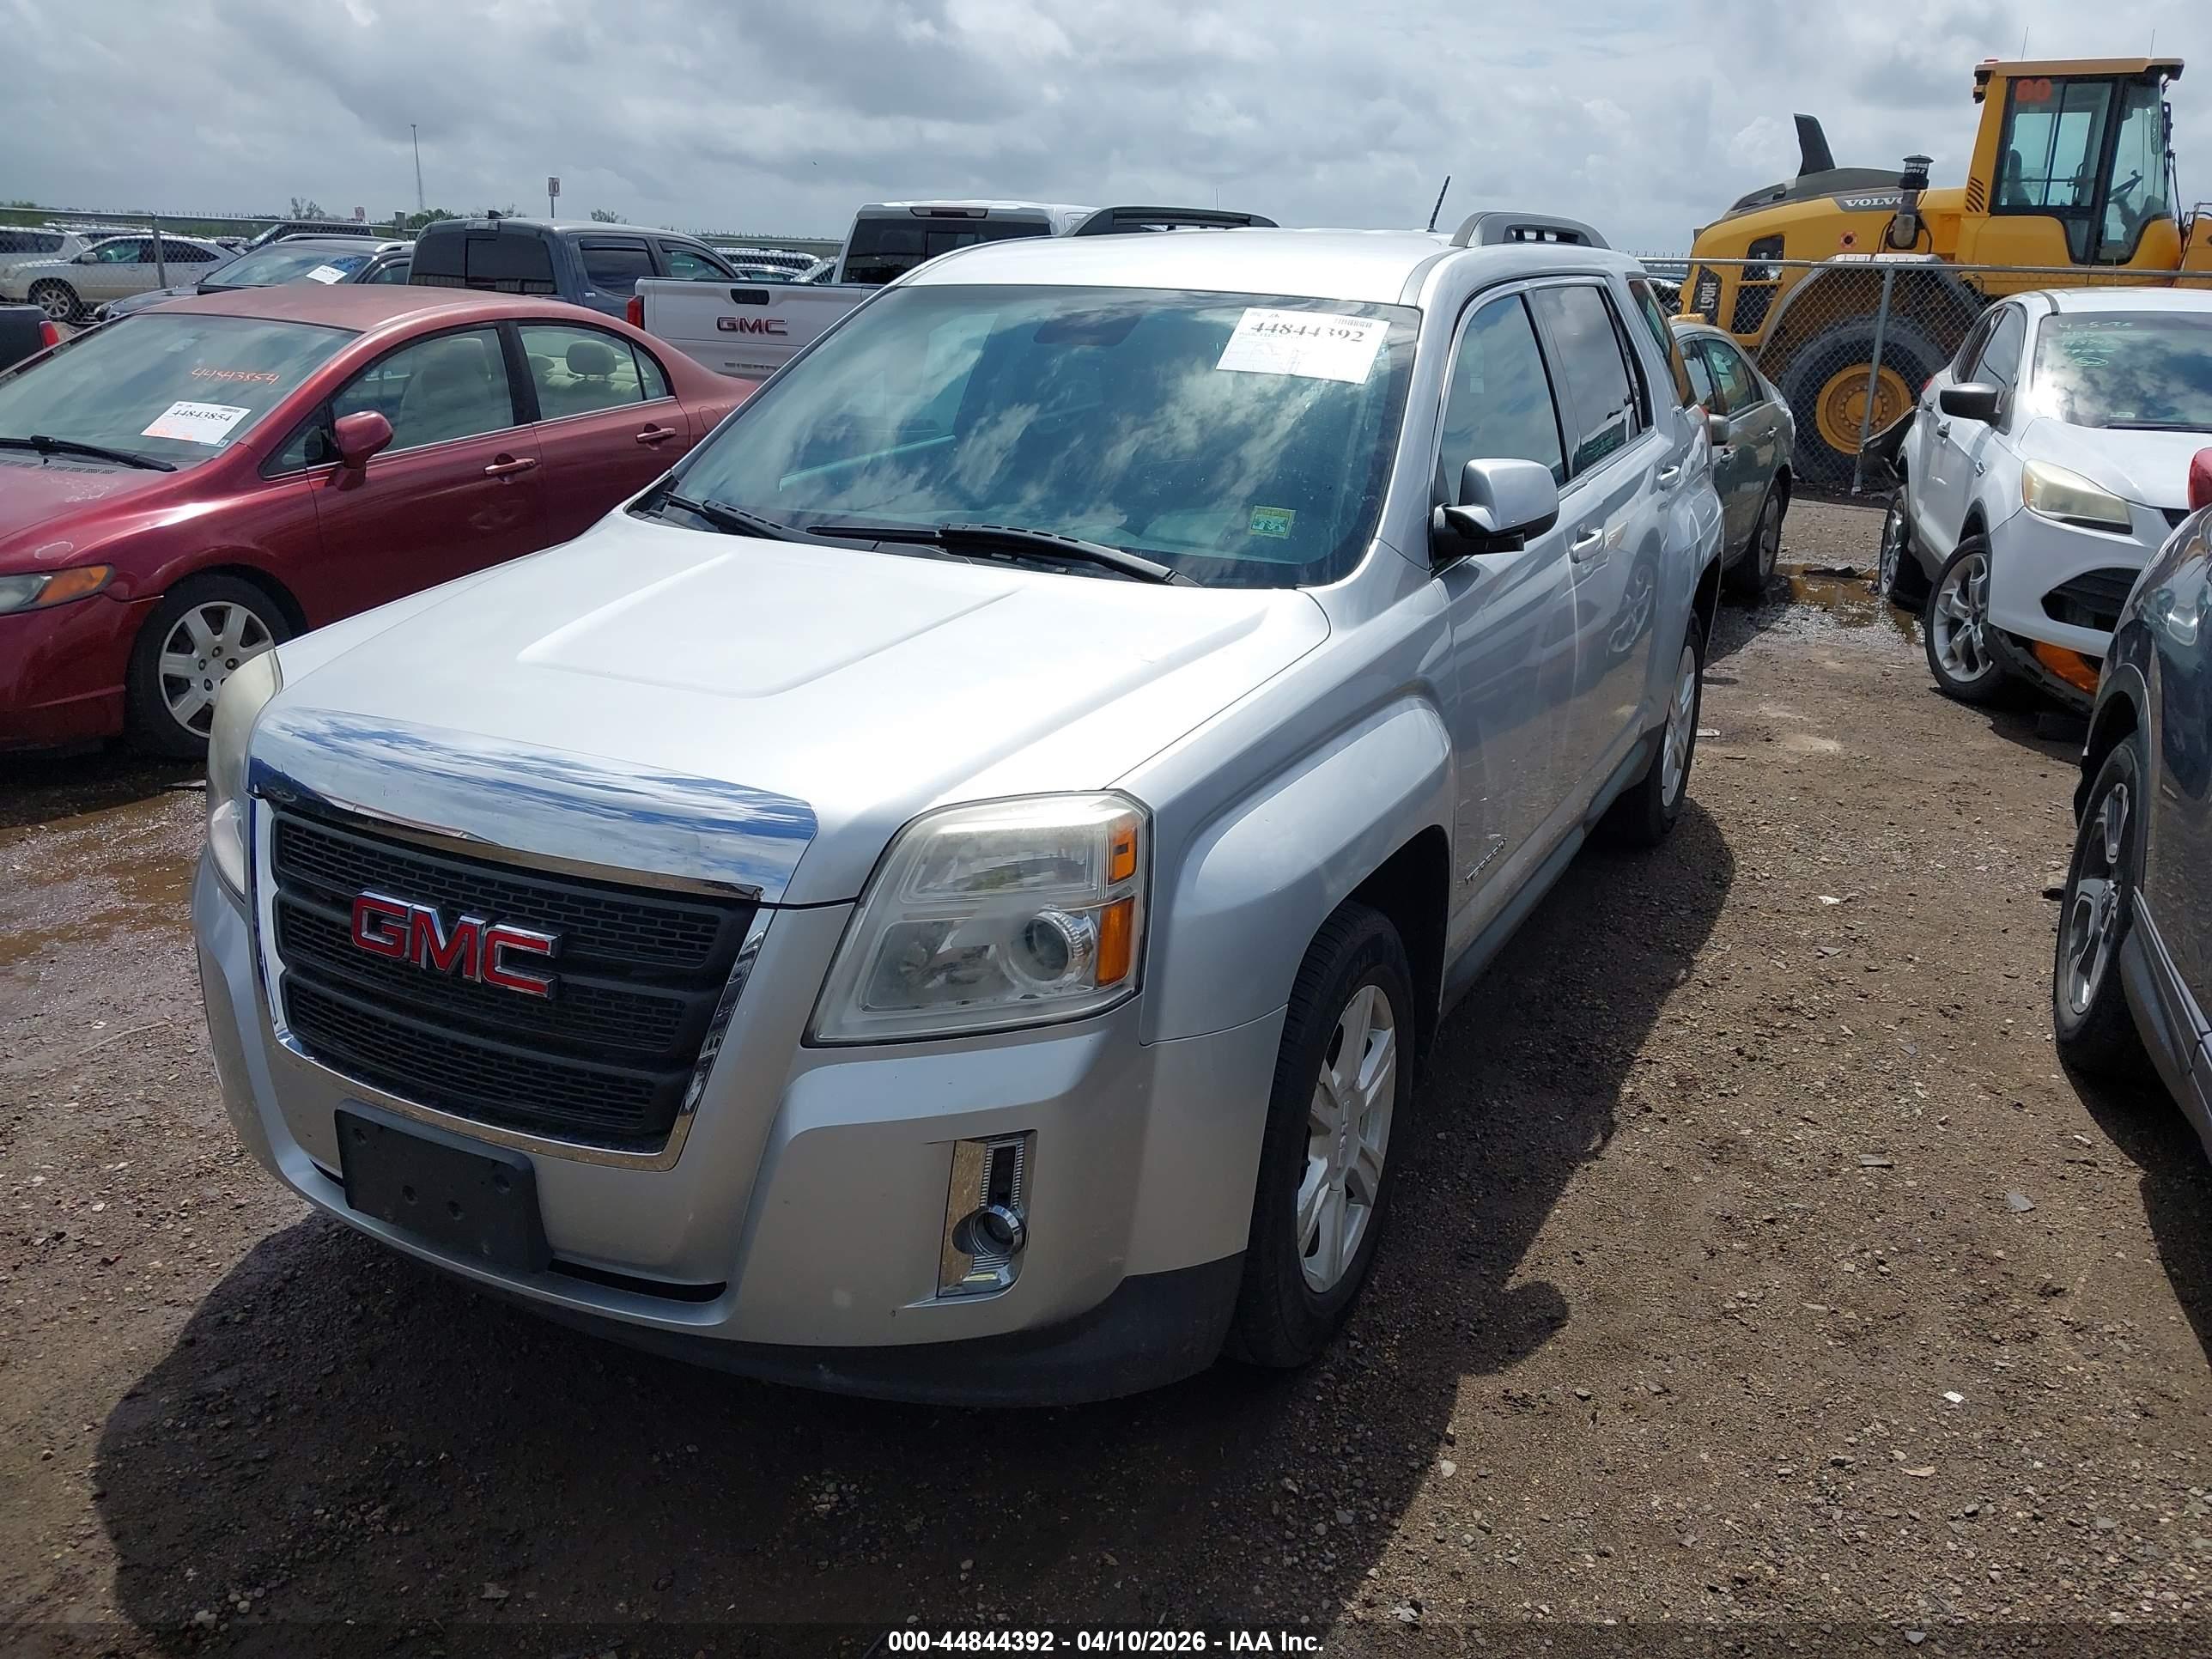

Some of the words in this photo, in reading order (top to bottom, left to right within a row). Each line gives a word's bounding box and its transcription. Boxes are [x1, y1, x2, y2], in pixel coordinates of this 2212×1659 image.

[1699, 283, 1717, 309] L90H
[716, 316, 788, 336] GMC
[1250, 322, 1365, 343] 44844392
[191, 368, 282, 386] 44843854
[724, 362, 782, 372] SIERR
[172, 409, 234, 422] 44843854
[351, 890, 560, 1000] GMC
